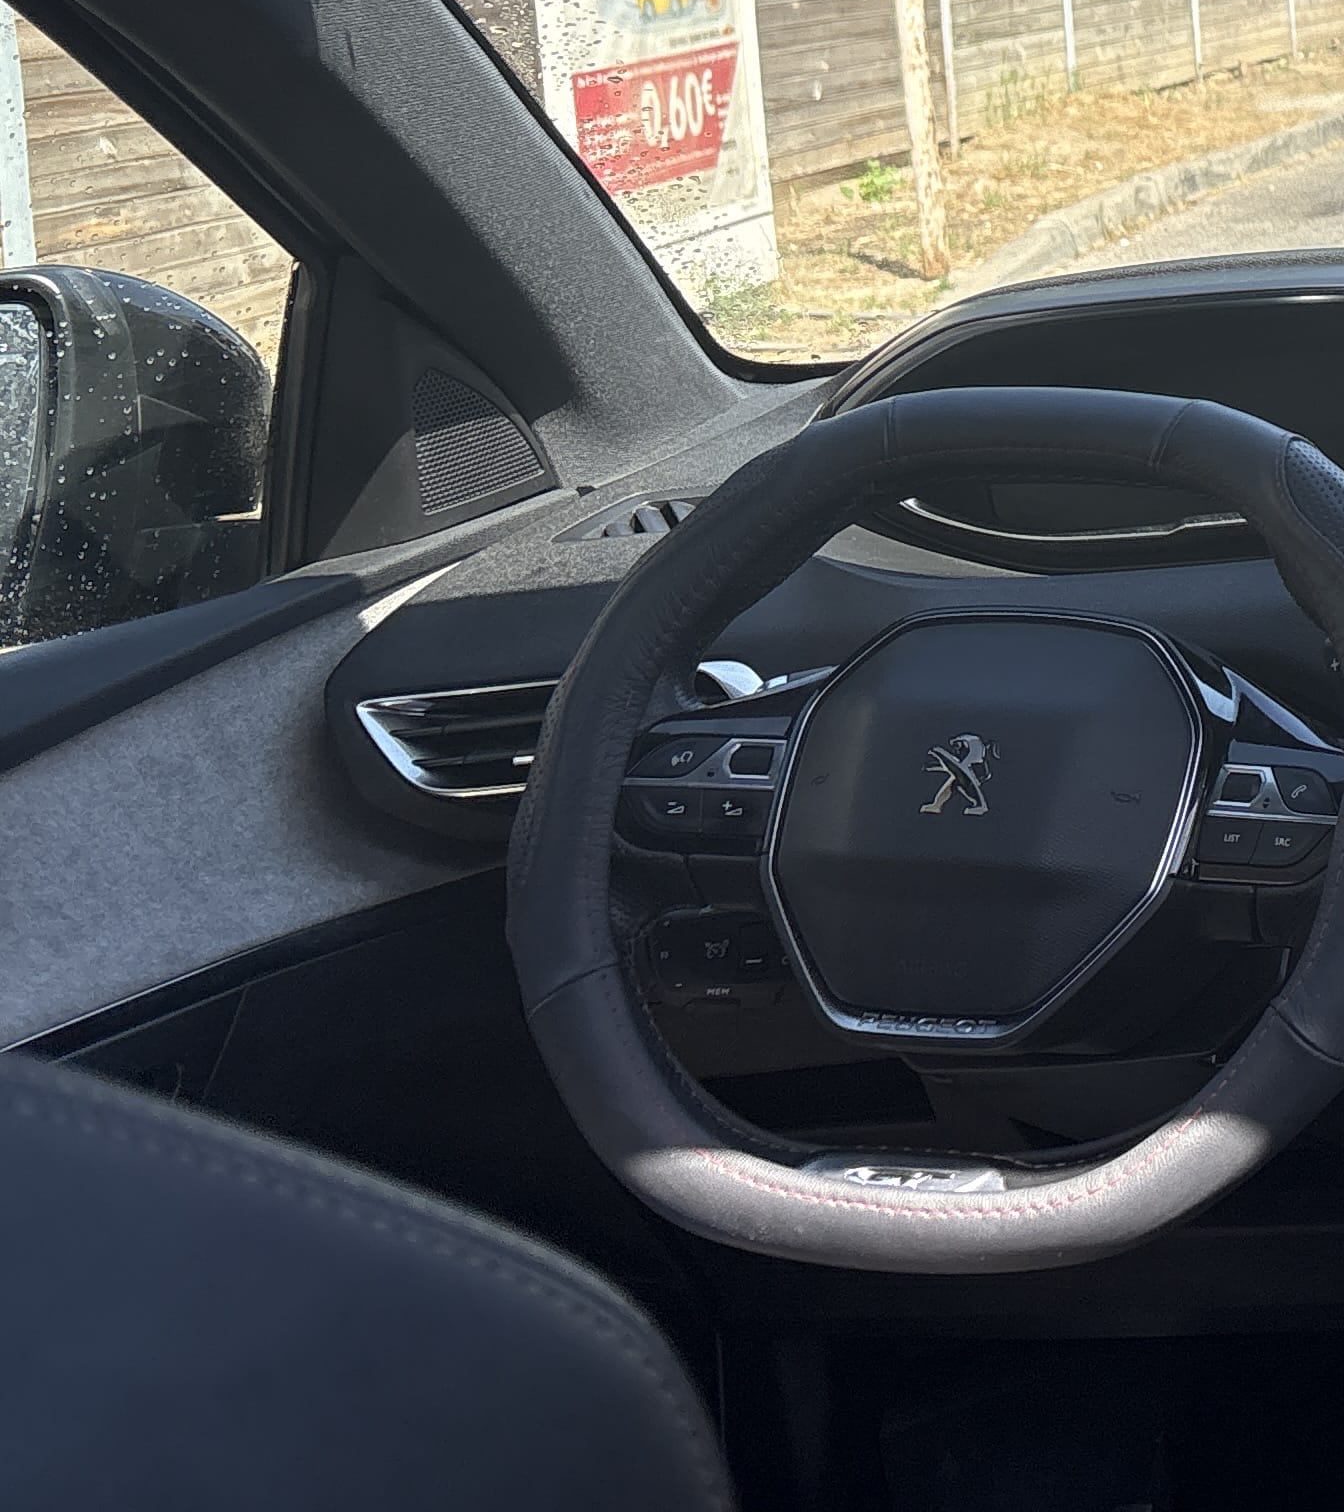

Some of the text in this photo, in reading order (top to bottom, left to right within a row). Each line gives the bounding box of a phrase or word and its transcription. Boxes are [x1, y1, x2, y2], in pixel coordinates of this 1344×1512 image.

[1223, 833, 1240, 843] LIST
[1274, 837, 1291, 847] SRC
[706, 987, 730, 996] MEM
